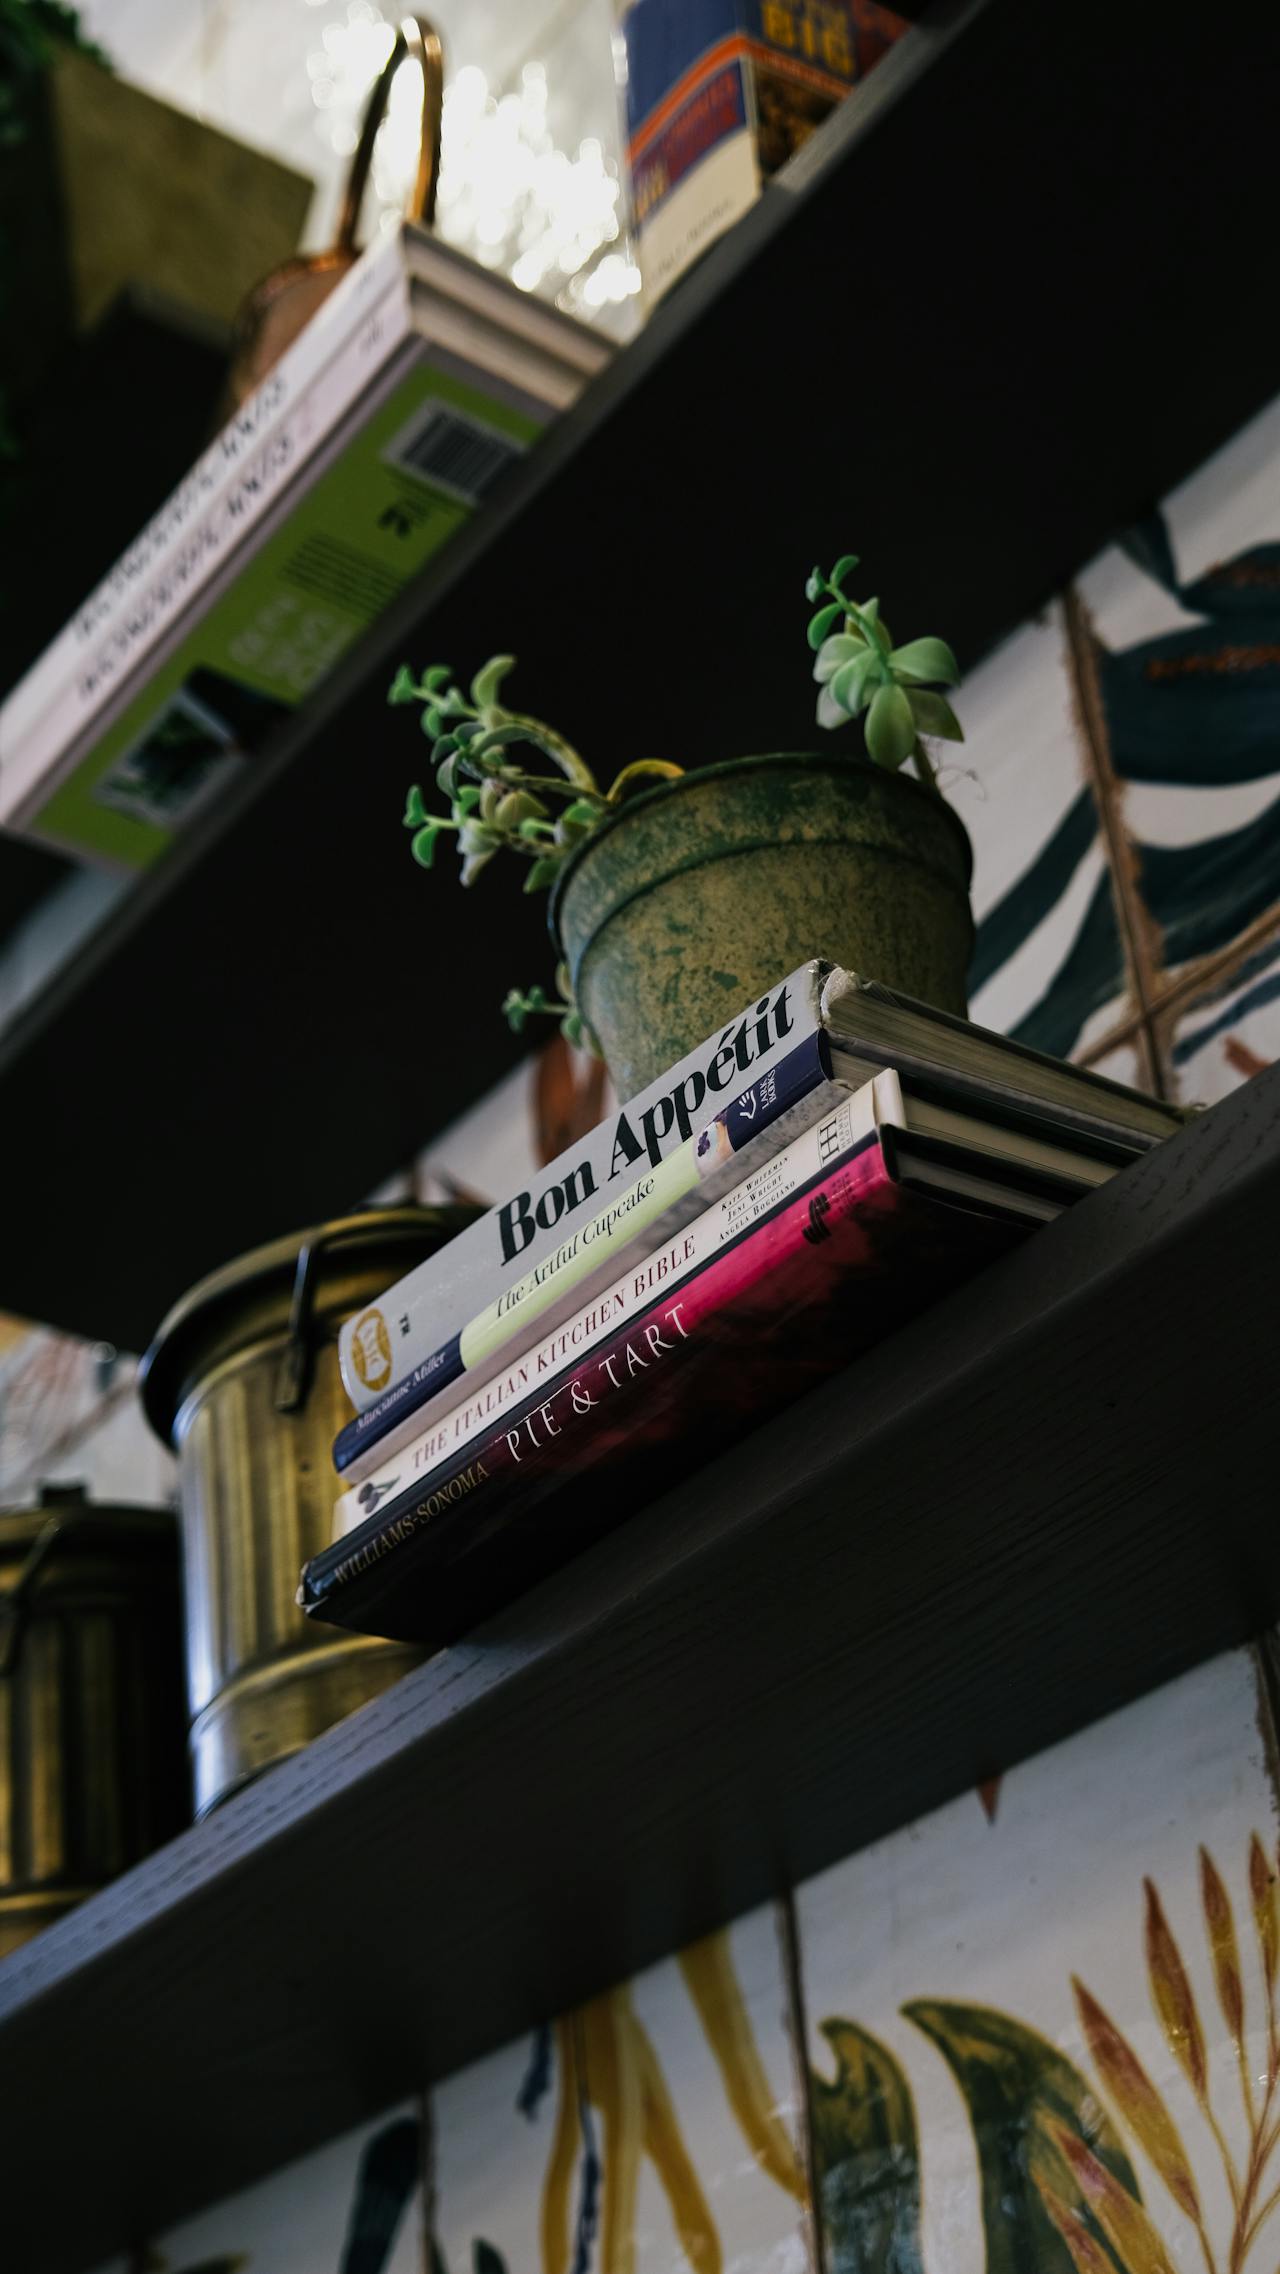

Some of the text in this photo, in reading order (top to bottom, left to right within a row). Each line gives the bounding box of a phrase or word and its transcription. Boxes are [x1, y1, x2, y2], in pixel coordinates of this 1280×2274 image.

[759, 1077, 769, 1110] LARK
[767, 1069, 777, 1103] BOOKS
[496, 984, 795, 1267] Bon Appétit
[718, 1215, 750, 1243] ANGELA
[753, 1180, 796, 1217] BOGGIANO
[720, 1156, 789, 1212] KATE WHITEMAN
[727, 1174, 783, 1222] JENI WRIGHT
[495, 1177, 656, 1318] The Artful Cupcake
[411, 1234, 697, 1469] THE ITALIAN KITCHEN BIBLE
[412, 1351, 447, 1387] Miller
[505, 1302, 691, 1463] PIE & TART
[333, 1460, 491, 1586] WILLIAMS-SONOMA
